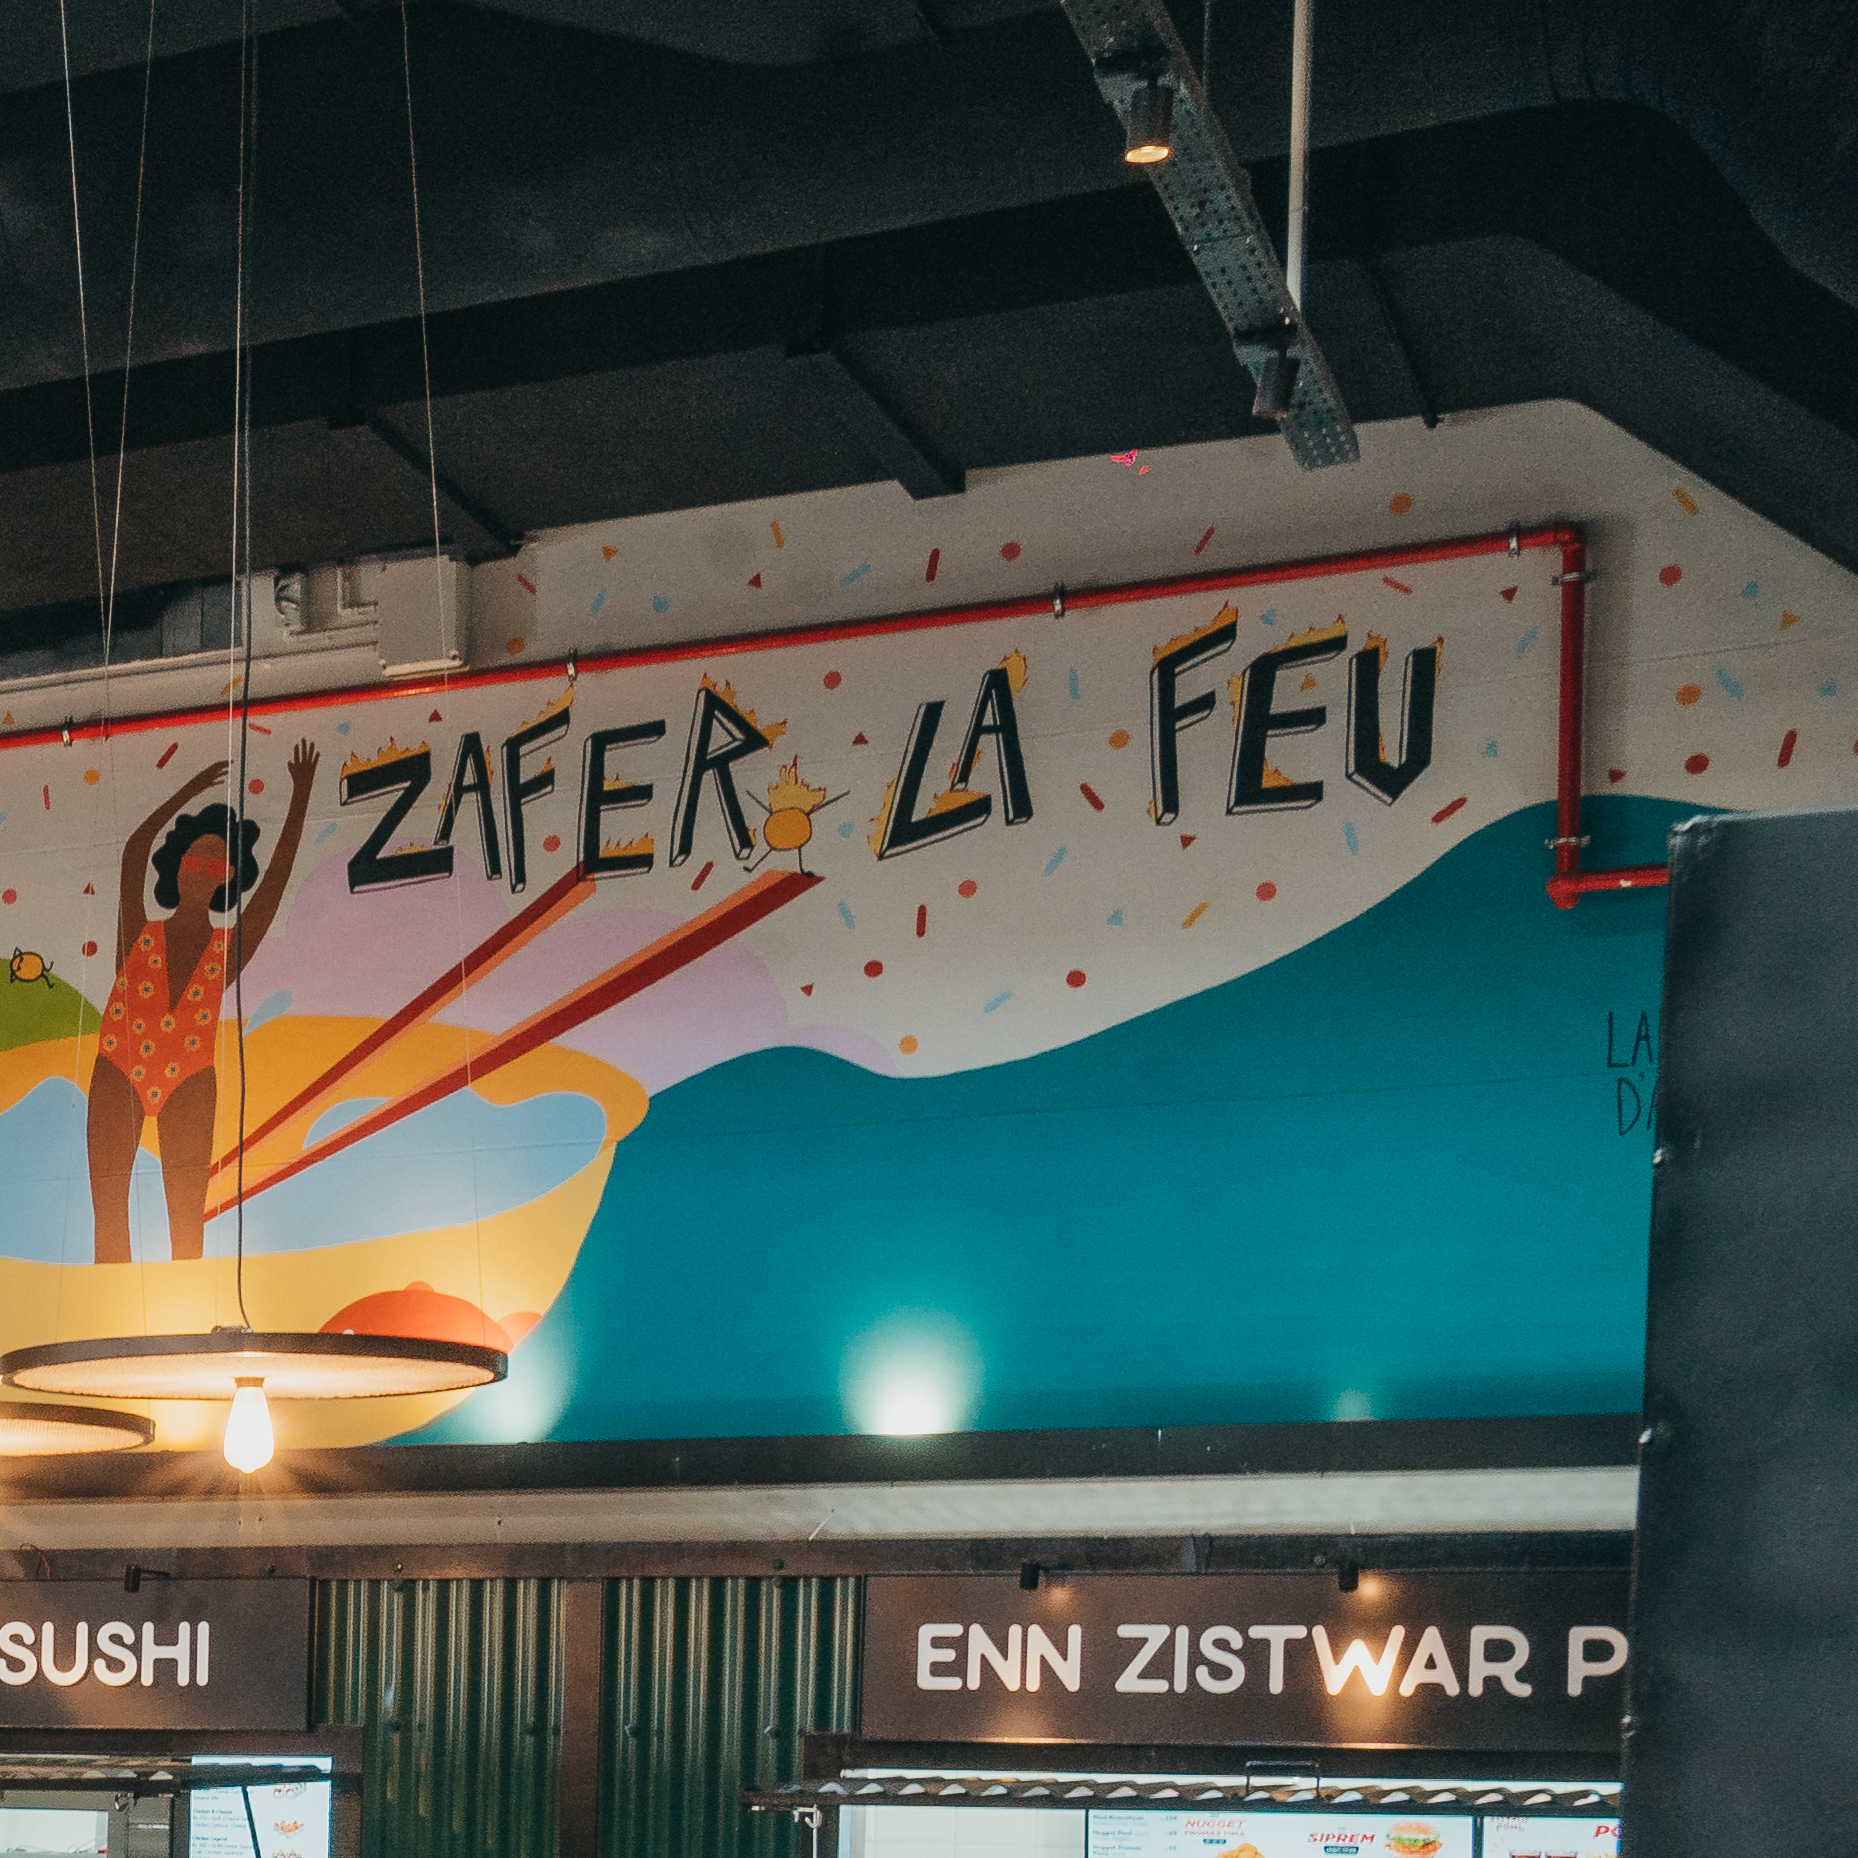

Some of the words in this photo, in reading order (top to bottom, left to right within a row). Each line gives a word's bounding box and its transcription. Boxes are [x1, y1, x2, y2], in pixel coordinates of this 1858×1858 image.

[339, 685, 770, 895] ZAFER
[878, 665, 1035, 861] LA
[1150, 617, 1440, 828] FEU
[915, 1622, 1083, 1694] ENN
[1114, 1623, 1534, 1698] ZISTWAR
[1307, 1832, 1377, 1844] SIPREM
